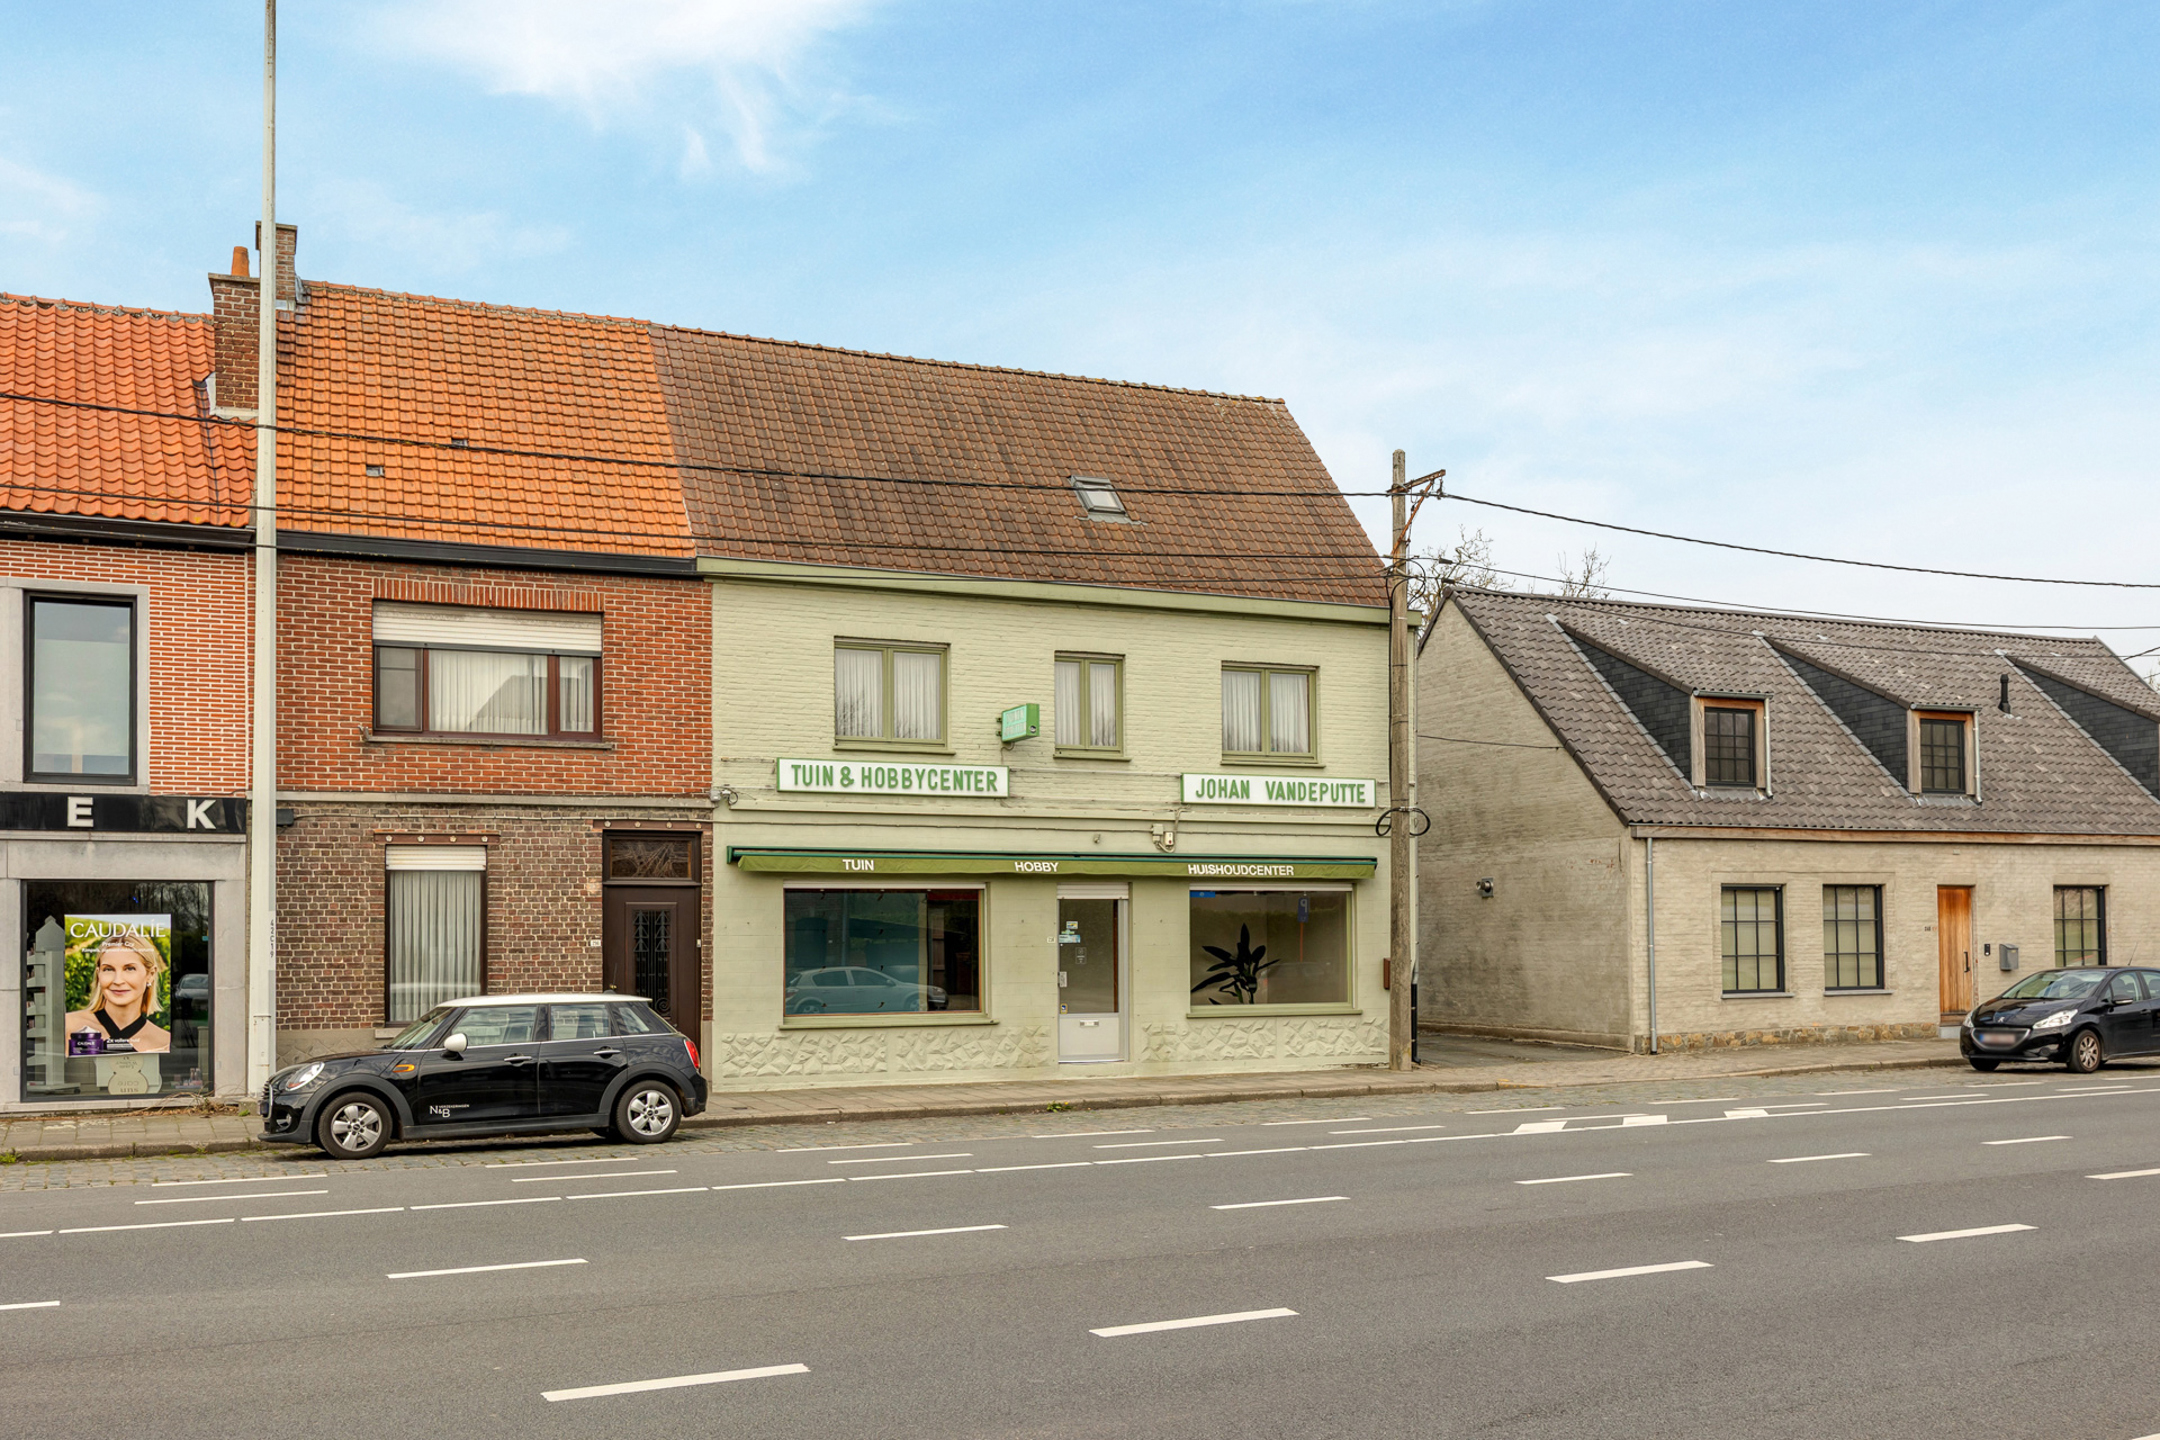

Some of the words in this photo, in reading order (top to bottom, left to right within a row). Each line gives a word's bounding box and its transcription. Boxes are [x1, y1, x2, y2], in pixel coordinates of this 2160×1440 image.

[791, 764, 834, 787] TUIN
[840, 766, 854, 788] &
[861, 767, 998, 792] HOBBYCENTER
[1195, 778, 1250, 799] JOHAN
[1266, 781, 1366, 803] VANDEPUTTE
[842, 859, 875, 871] TUIN
[1014, 861, 1059, 873] HOBBY
[1188, 864, 1294, 876] HUISHOUDCENTER
